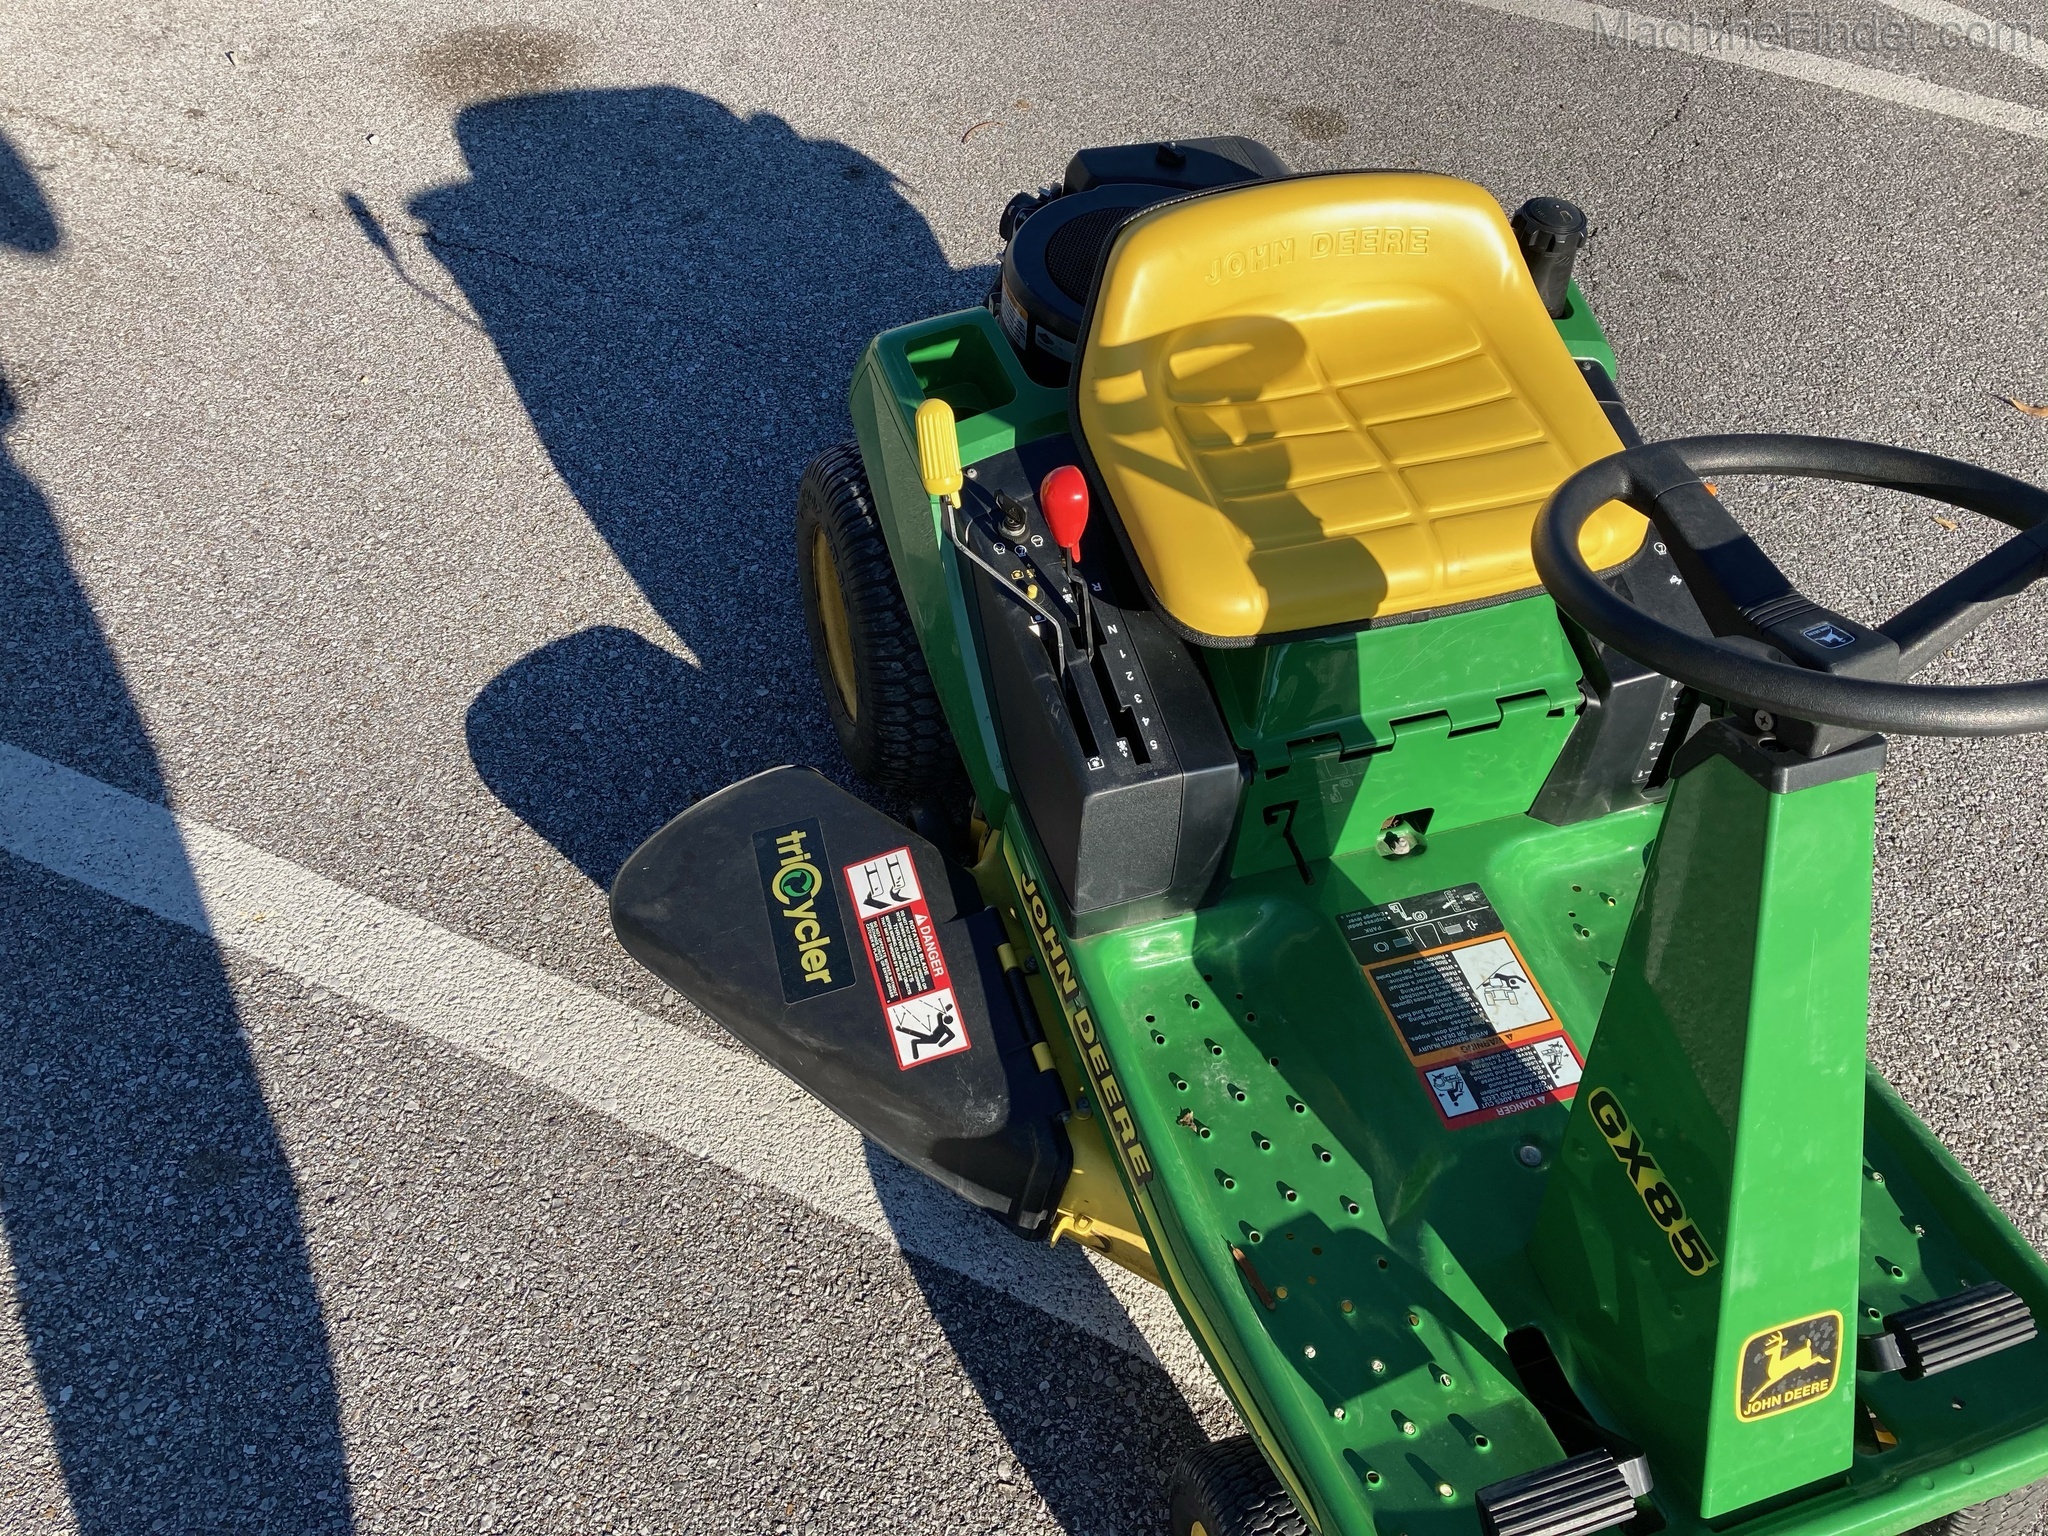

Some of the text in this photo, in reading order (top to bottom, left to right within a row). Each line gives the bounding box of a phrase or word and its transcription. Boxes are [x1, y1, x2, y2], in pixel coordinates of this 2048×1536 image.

[1204, 226, 1430, 286] JOHN DEERE
[1091, 582, 1102, 592] R
[1107, 624, 1118, 634] N
[1119, 650, 1126, 659] 1
[1125, 671, 1134, 681] 2
[1133, 693, 1143, 704] 3
[1141, 716, 1150, 726] 4
[1150, 740, 1158, 750] 5
[772, 830, 832, 984] triCycler
[1346, 915, 1363, 924] lever
[1361, 910, 1385, 920] Engage
[1345, 915, 1387, 930] Depress pedal
[1363, 924, 1382, 933] PARK
[892, 922, 914, 982] THROWN OBJECTS
[907, 919, 929, 975] ROTATING BLADE
[919, 924, 945, 977] DANGER
[1413, 963, 1454, 977] When leaving
[1440, 969, 1458, 978] Read
[1387, 981, 1411, 991] manual
[1443, 1002, 1470, 1013] machine
[1459, 1007, 1479, 1016] Avoid
[1407, 1013, 1426, 1022] going
[1425, 1008, 1444, 1018] stops
[1436, 1012, 1460, 1022] sudden
[1419, 1018, 1437, 1026] turns
[1449, 1016, 1471, 1025] across
[1021, 873, 1152, 1181] JOHN DEERE
[1430, 1027, 1448, 1036] down
[1447, 1024, 1460, 1032] and
[1416, 1030, 1489, 1052] AVOID SERIOUS INJURY
[1433, 1032, 1456, 1042] DEATH
[1470, 1050, 1533, 1070] Never carry children
[1523, 1059, 1538, 1067] Look
[1505, 1064, 1523, 1072] down
[1507, 1069, 1523, 1077] mow
[1472, 1071, 1494, 1081] behind
[1479, 1075, 1502, 1085] reverse
[1500, 1082, 1516, 1090] when
[1515, 1078, 1529, 1086] mow
[1478, 1086, 1501, 1096] children
[1480, 1079, 1547, 1102] OFF ARMS AND LEGS
[1479, 1084, 1554, 1109] ROTATING BLADES CUT
[1495, 1098, 1537, 1116] DANGER
[1589, 1088, 1718, 1275] GX85
[1743, 1379, 1828, 1416] JOHN DEERE
